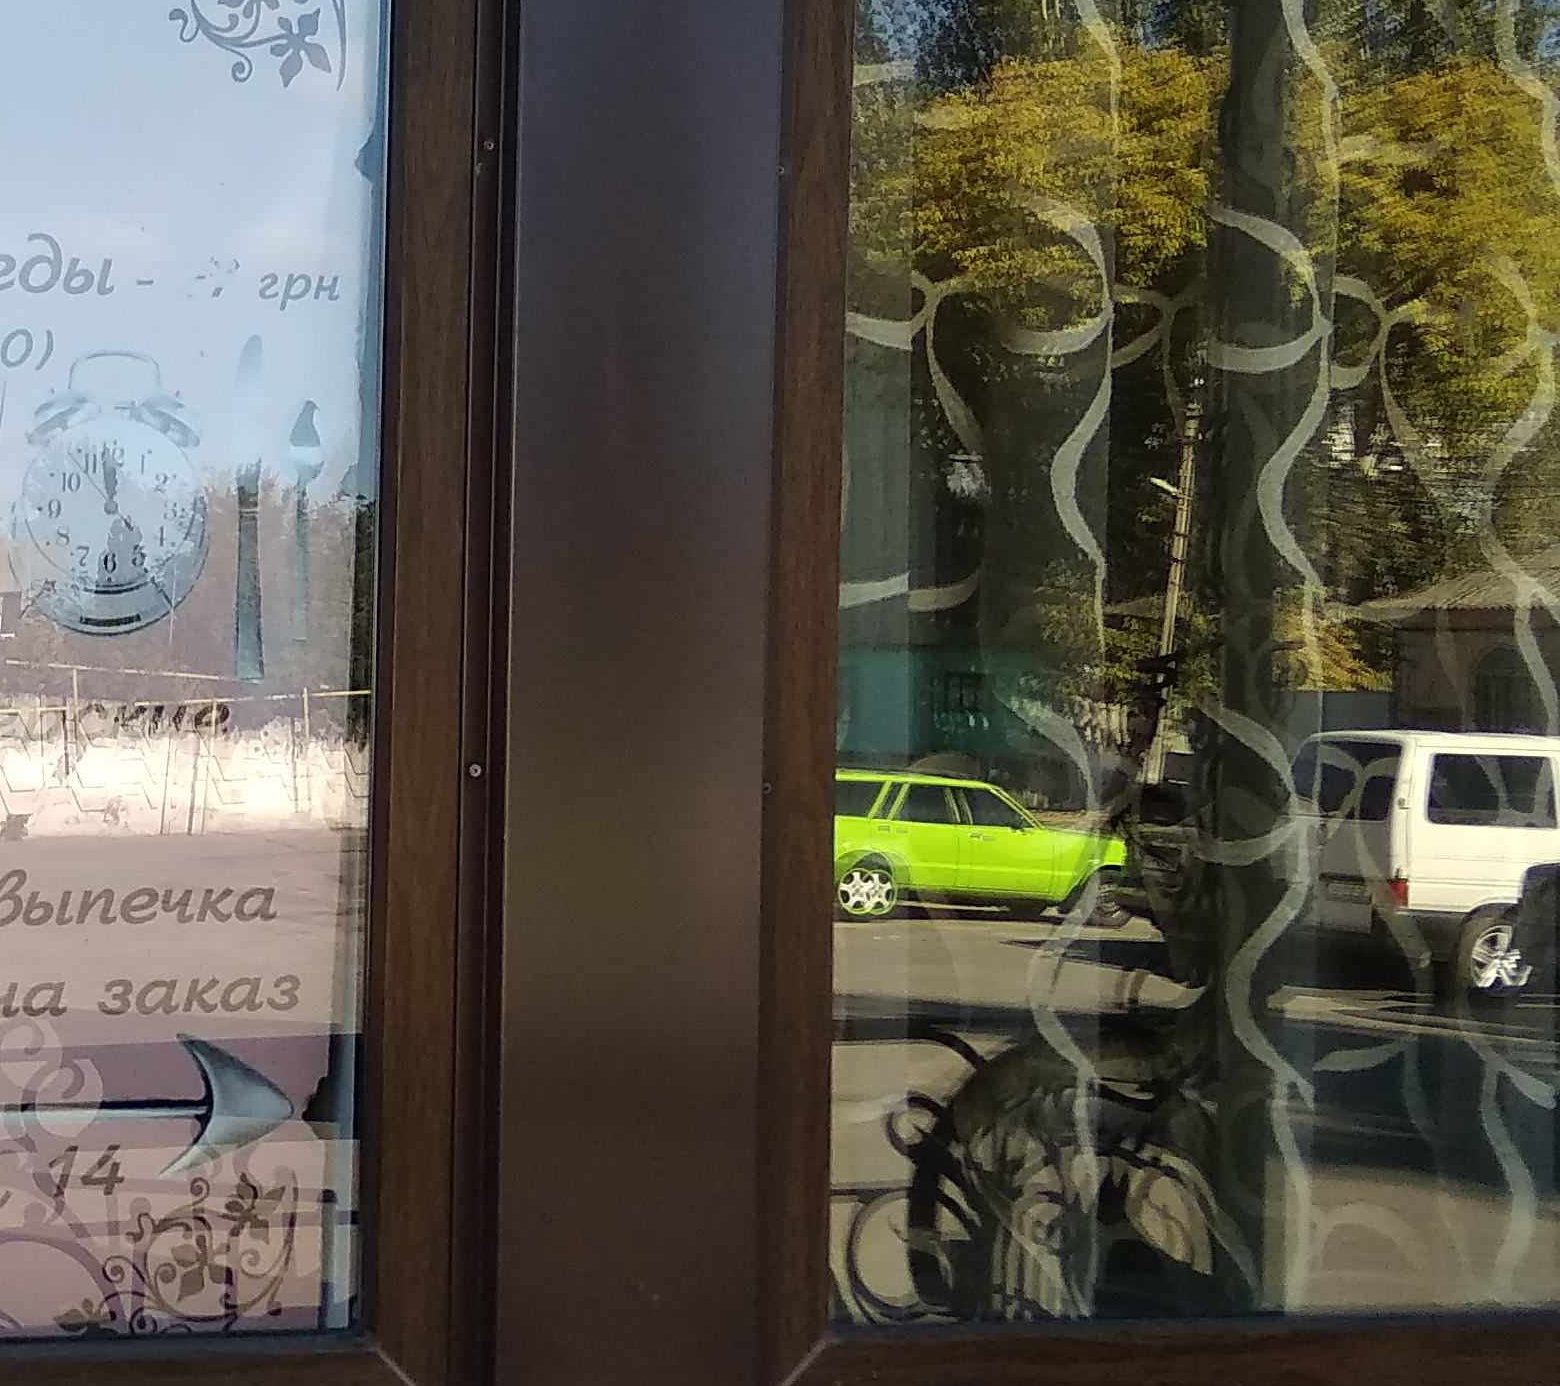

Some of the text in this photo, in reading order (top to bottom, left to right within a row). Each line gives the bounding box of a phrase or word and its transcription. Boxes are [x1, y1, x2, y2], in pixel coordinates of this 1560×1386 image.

[257, 271, 341, 311] грн
[96, 971, 303, 1016] заказ
[46, 1143, 127, 1210] 14
